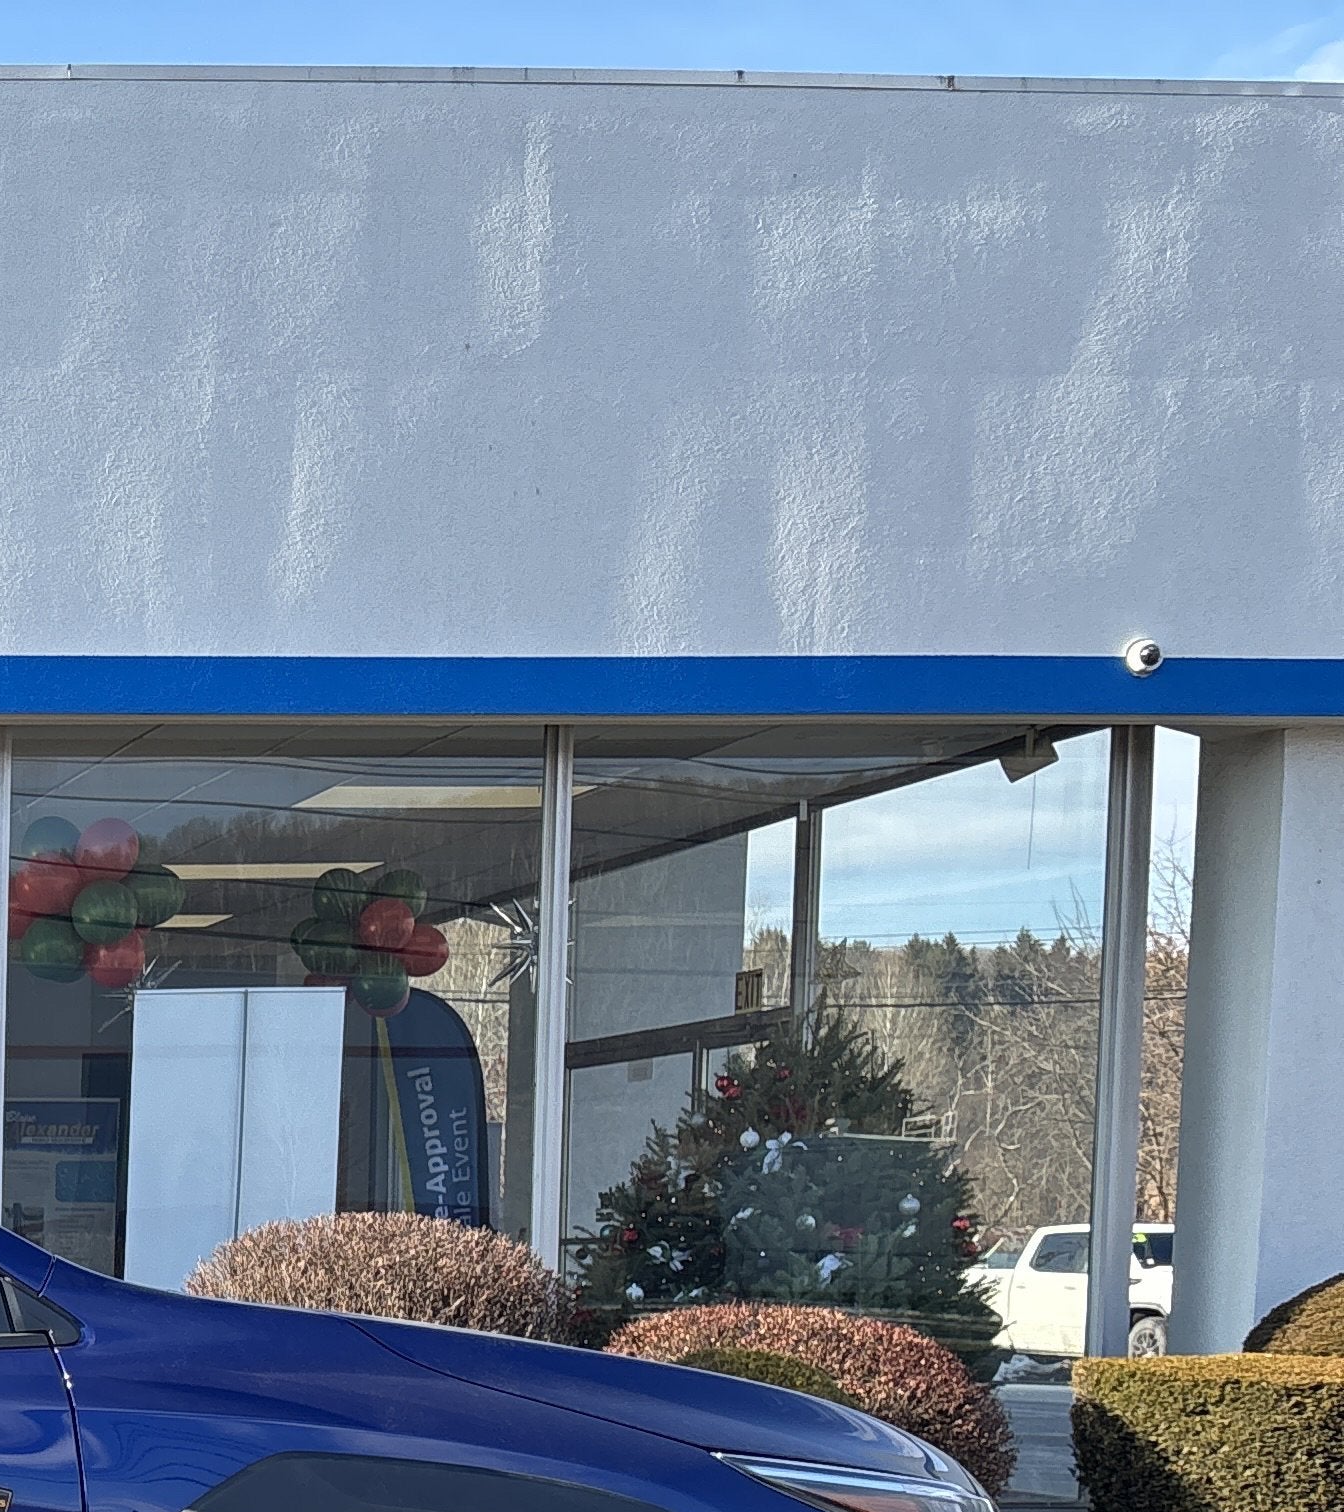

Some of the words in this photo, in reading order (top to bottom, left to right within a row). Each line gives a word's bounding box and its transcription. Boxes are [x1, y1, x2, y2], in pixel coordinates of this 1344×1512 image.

[735, 972, 762, 1009] EXIT
[406, 1066, 450, 1219] e-Approval
[450, 1106, 471, 1183] Event
